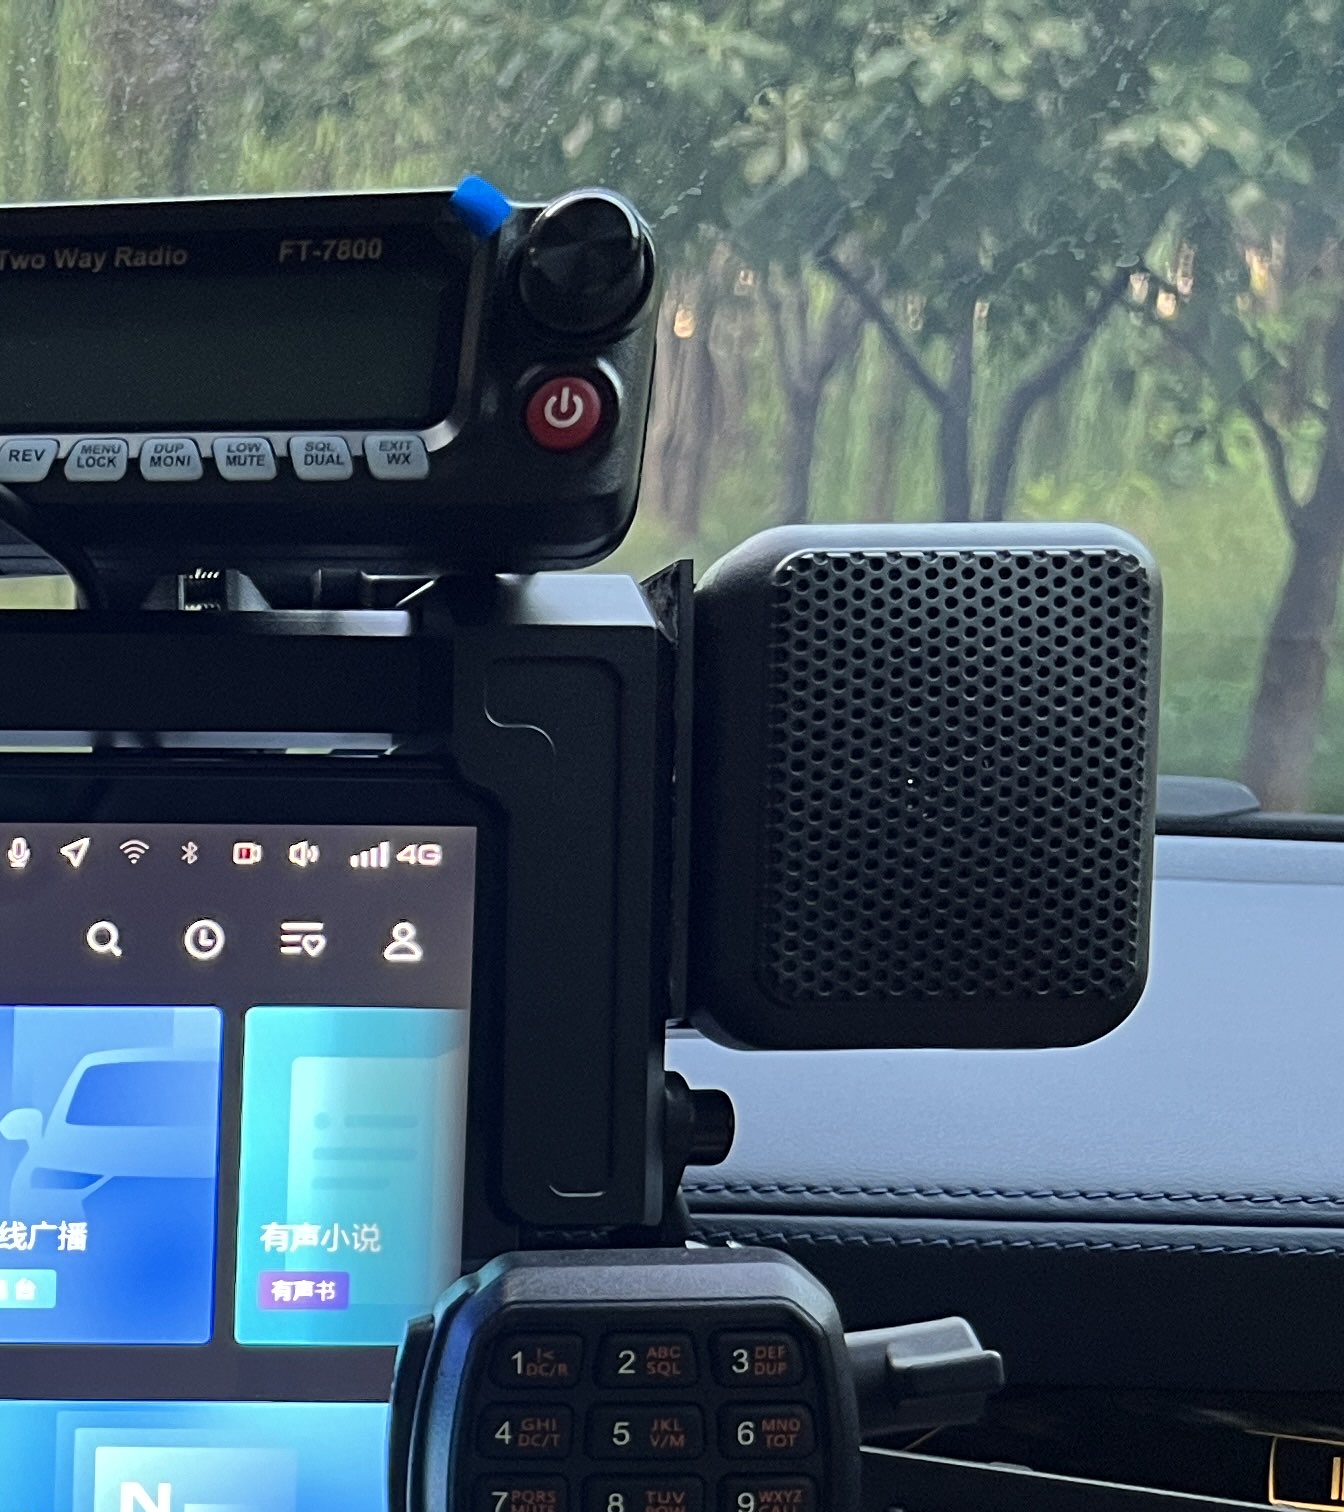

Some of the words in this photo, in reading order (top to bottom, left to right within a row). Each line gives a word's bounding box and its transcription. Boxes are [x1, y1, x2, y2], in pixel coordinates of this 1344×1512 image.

[278, 238, 383, 264] FT-7800
[54, 249, 107, 273] Way
[114, 246, 189, 268] Radio
[80, 444, 122, 456] MENU
[153, 443, 185, 455] DUP
[226, 442, 263, 453] LOW
[304, 441, 335, 453] SQL
[378, 440, 412, 452] EXIT
[8, 448, 46, 463] REV
[76, 456, 118, 469] LOCK
[149, 455, 191, 468] MONI
[225, 454, 265, 467] MUTE
[303, 453, 345, 466] DUAL
[386, 453, 412, 465] WX
[395, 843, 444, 866] 4G
[259, 1221, 382, 1254] 有声小说
[270, 1279, 336, 1302] 有声书
[646, 1346, 682, 1360] ABC
[754, 1346, 786, 1360] DEF
[511, 1350, 525, 1376] 1
[617, 1349, 636, 1375] 2
[731, 1349, 750, 1374] 3
[754, 1361, 788, 1375] DUP
[646, 1361, 682, 1377] SQL
[520, 1417, 558, 1432] GHI
[651, 1418, 682, 1432] JKL
[494, 1420, 512, 1446] 4
[612, 1421, 631, 1446] 5
[736, 1421, 755, 1446] 6
[649, 1433, 686, 1448] V/M
[511, 1490, 557, 1504] PQRS
[646, 1491, 685, 1505] TUV
[759, 1489, 803, 1504] WXYZ
